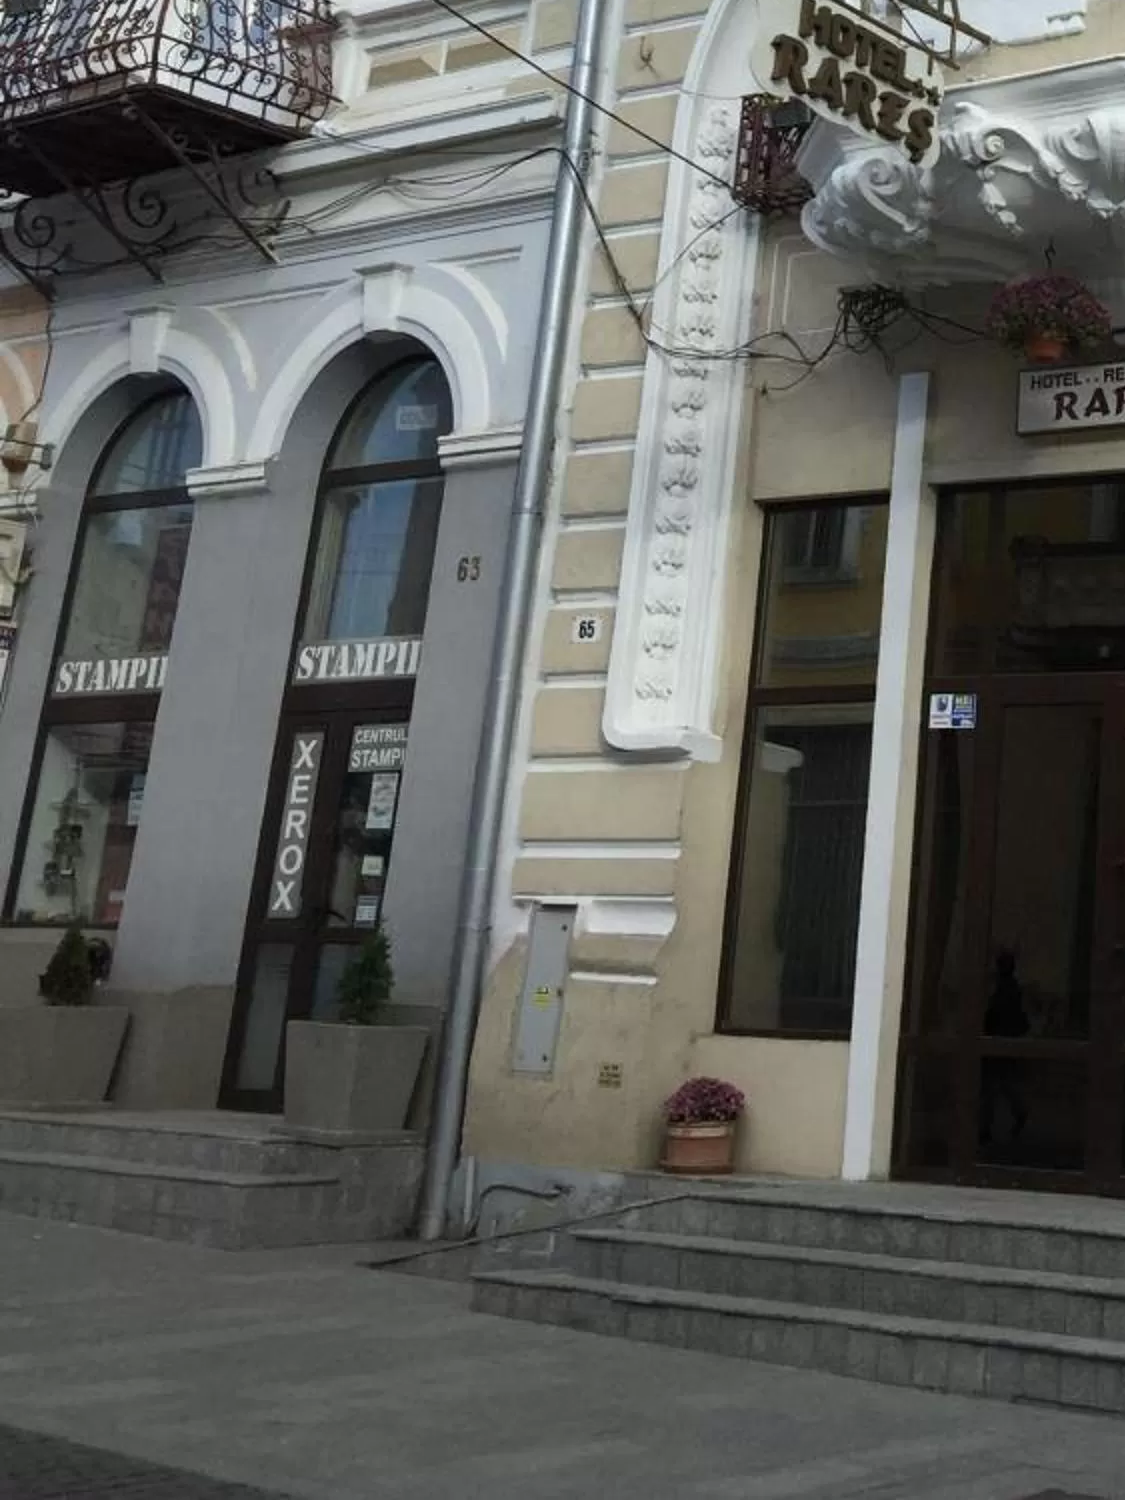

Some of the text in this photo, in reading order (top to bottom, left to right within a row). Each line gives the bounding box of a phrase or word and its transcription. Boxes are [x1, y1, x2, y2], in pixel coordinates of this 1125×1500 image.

[1031, 372, 1082, 390] HOTEL
[457, 556, 482, 582] 63
[578, 620, 596, 639] 65
[271, 738, 318, 912] XEROX
